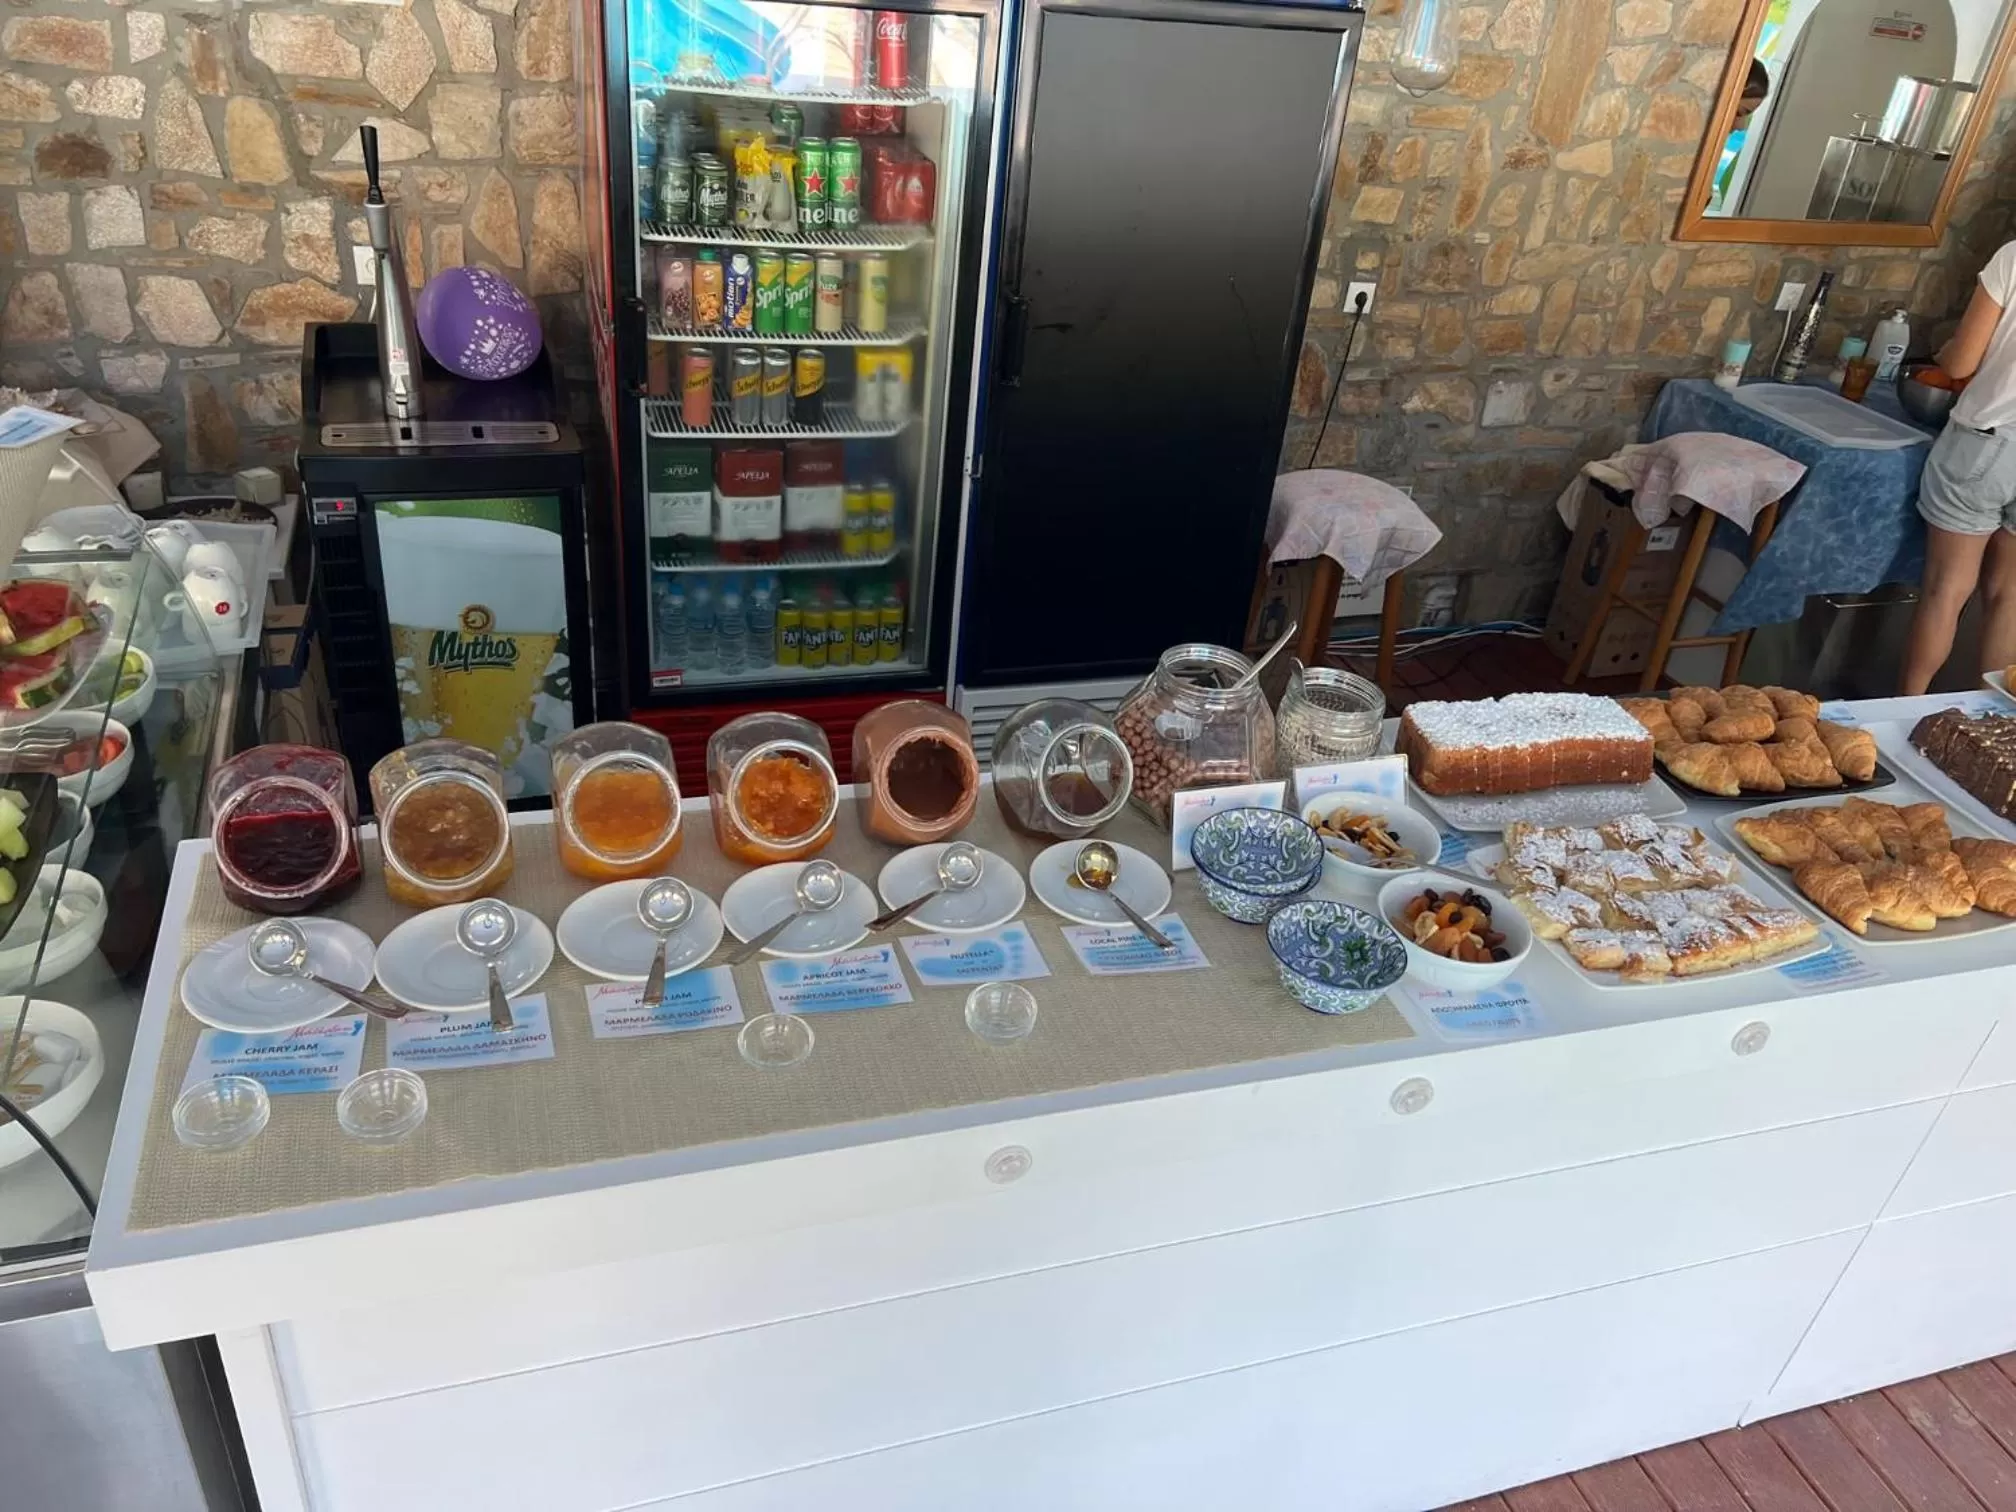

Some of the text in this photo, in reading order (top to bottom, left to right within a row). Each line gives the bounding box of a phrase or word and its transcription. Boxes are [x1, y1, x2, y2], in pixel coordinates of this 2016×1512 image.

[428, 630, 519, 673] Mythos
[440, 1023, 473, 1033] PLUM
[245, 1042, 319, 1055] CHERRY JAM
